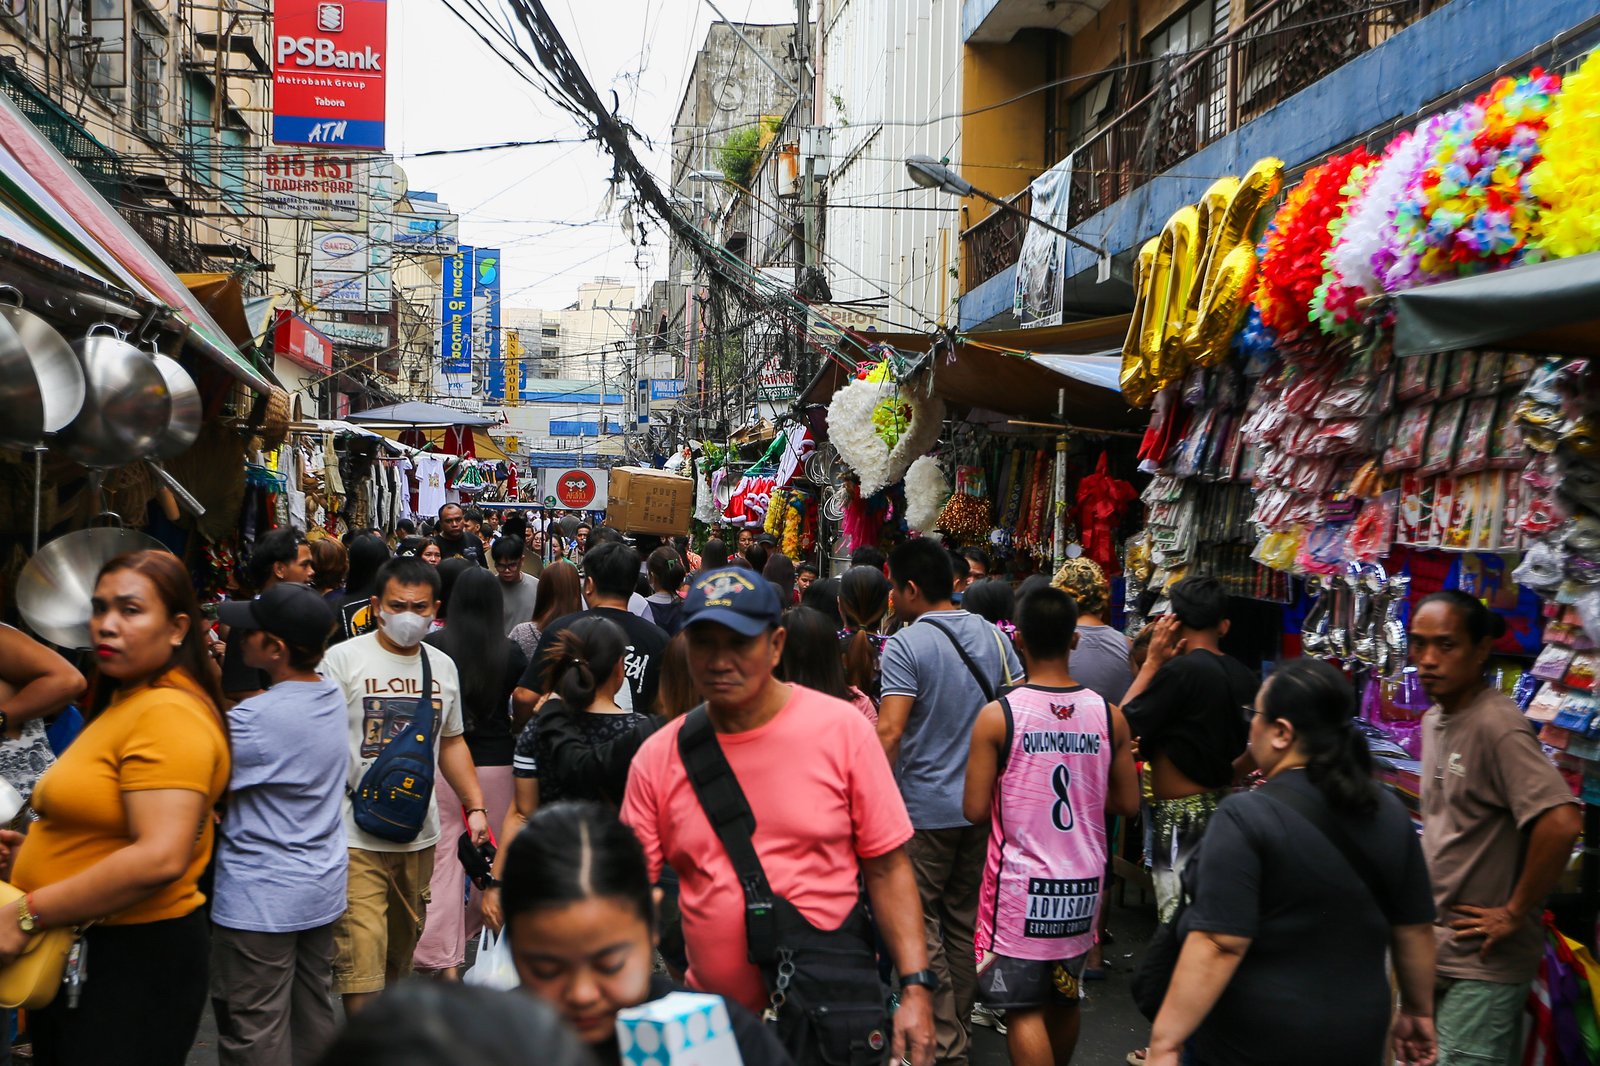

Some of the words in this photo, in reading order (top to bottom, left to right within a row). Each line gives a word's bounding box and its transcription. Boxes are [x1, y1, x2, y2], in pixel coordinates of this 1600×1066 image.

[277, 35, 381, 70] PSBank
[277, 76, 333, 87] Metrobank
[335, 79, 366, 90] Group
[315, 96, 345, 107] Tabora
[308, 121, 347, 143] ATM
[266, 154, 305, 176] 815
[313, 156, 355, 179] KST
[266, 179, 318, 192] TRADERS
[449, 301, 466, 311] OF
[831, 311, 877, 324] PILOT
[451, 314, 463, 360] DECOR
[1051, 763, 1075, 832] 8
[1033, 881, 1098, 894] PARENTAL
[1029, 896, 1097, 918] ADVISORY
[1029, 922, 1065, 935] EXPLICIT
